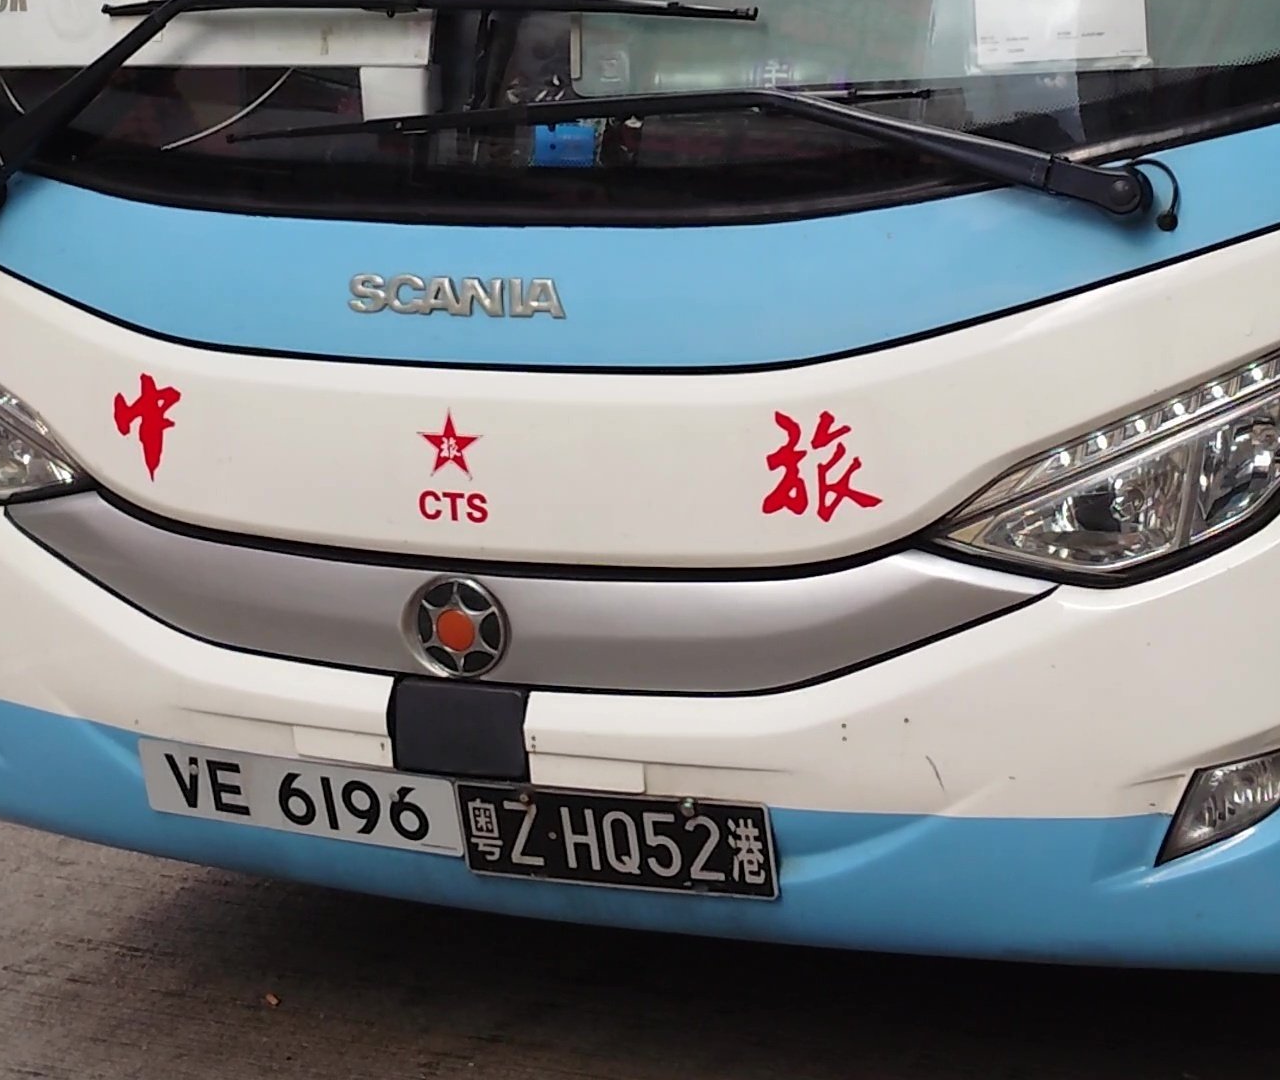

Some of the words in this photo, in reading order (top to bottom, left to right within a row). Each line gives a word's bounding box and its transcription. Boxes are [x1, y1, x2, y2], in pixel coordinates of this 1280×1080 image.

[348, 273, 566, 320] SCANIA
[114, 373, 182, 482] 中
[762, 410, 883, 522] 旅
[418, 490, 489, 523] CTS
[163, 752, 251, 816] VE
[278, 772, 430, 841] 6196
